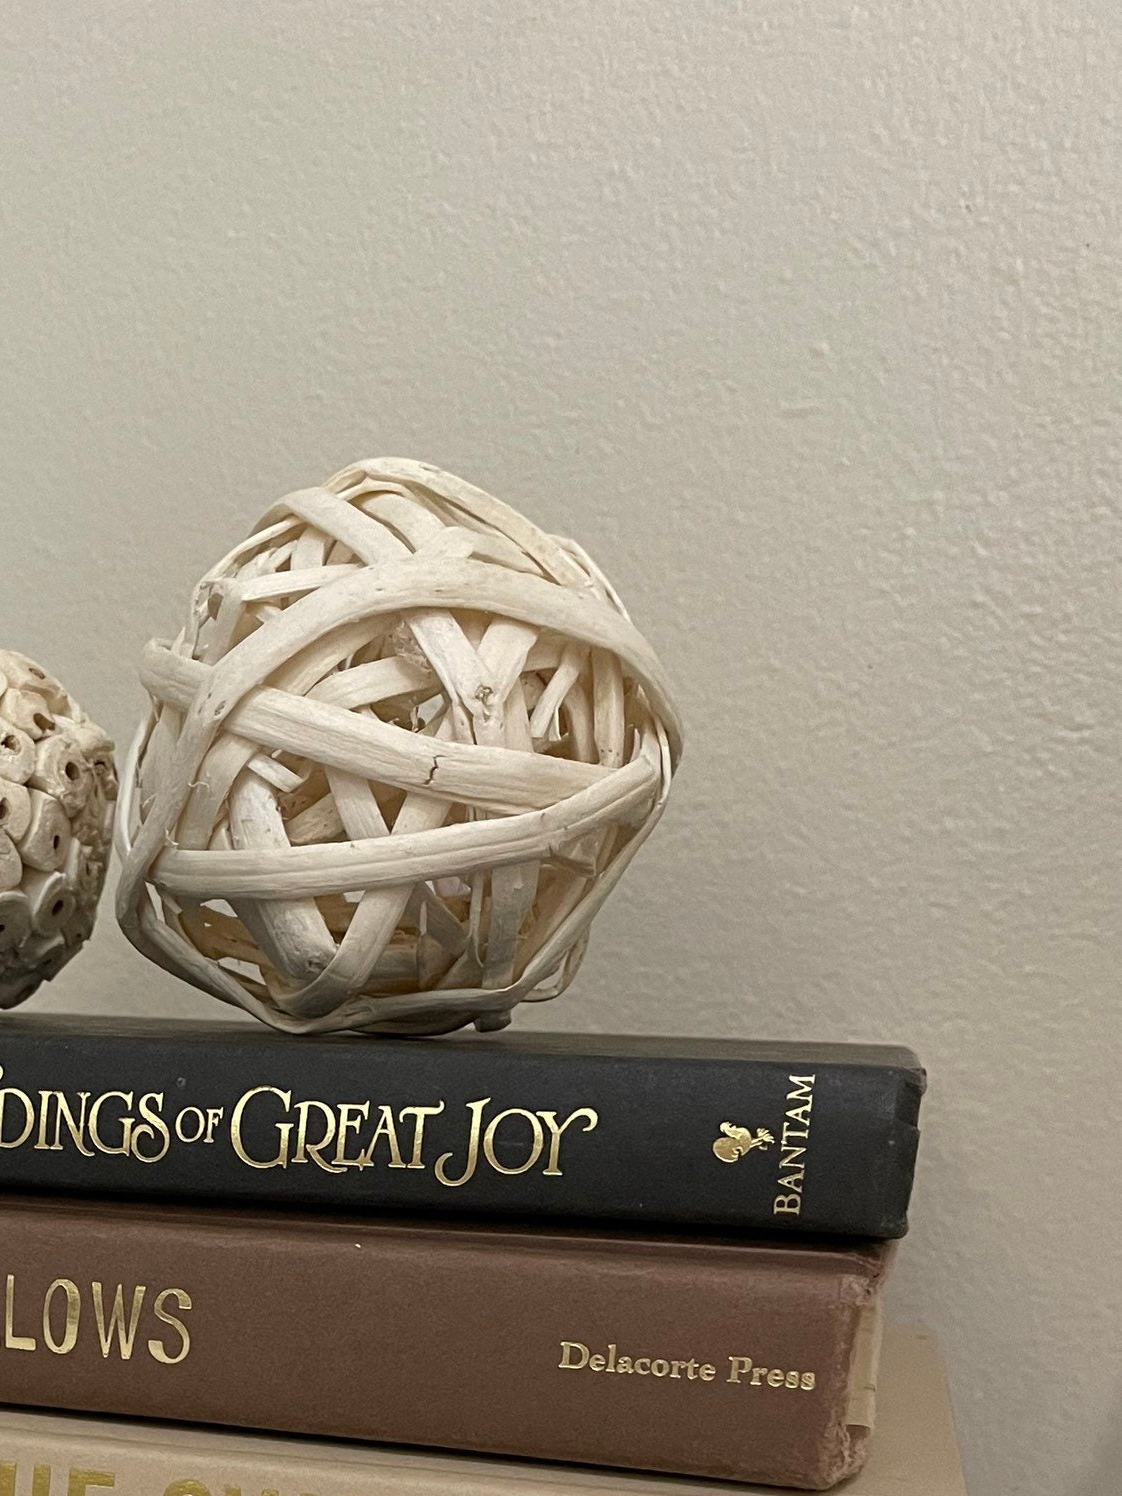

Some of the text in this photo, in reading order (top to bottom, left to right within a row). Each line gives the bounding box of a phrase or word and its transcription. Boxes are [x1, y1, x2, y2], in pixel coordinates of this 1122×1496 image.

[175, 1105, 224, 1144] OF
[231, 1086, 446, 1173] GREAT
[434, 1097, 598, 1187] JOY
[774, 1073, 816, 1216] BANTAM
[558, 1340, 816, 1391] Delacorte Press
